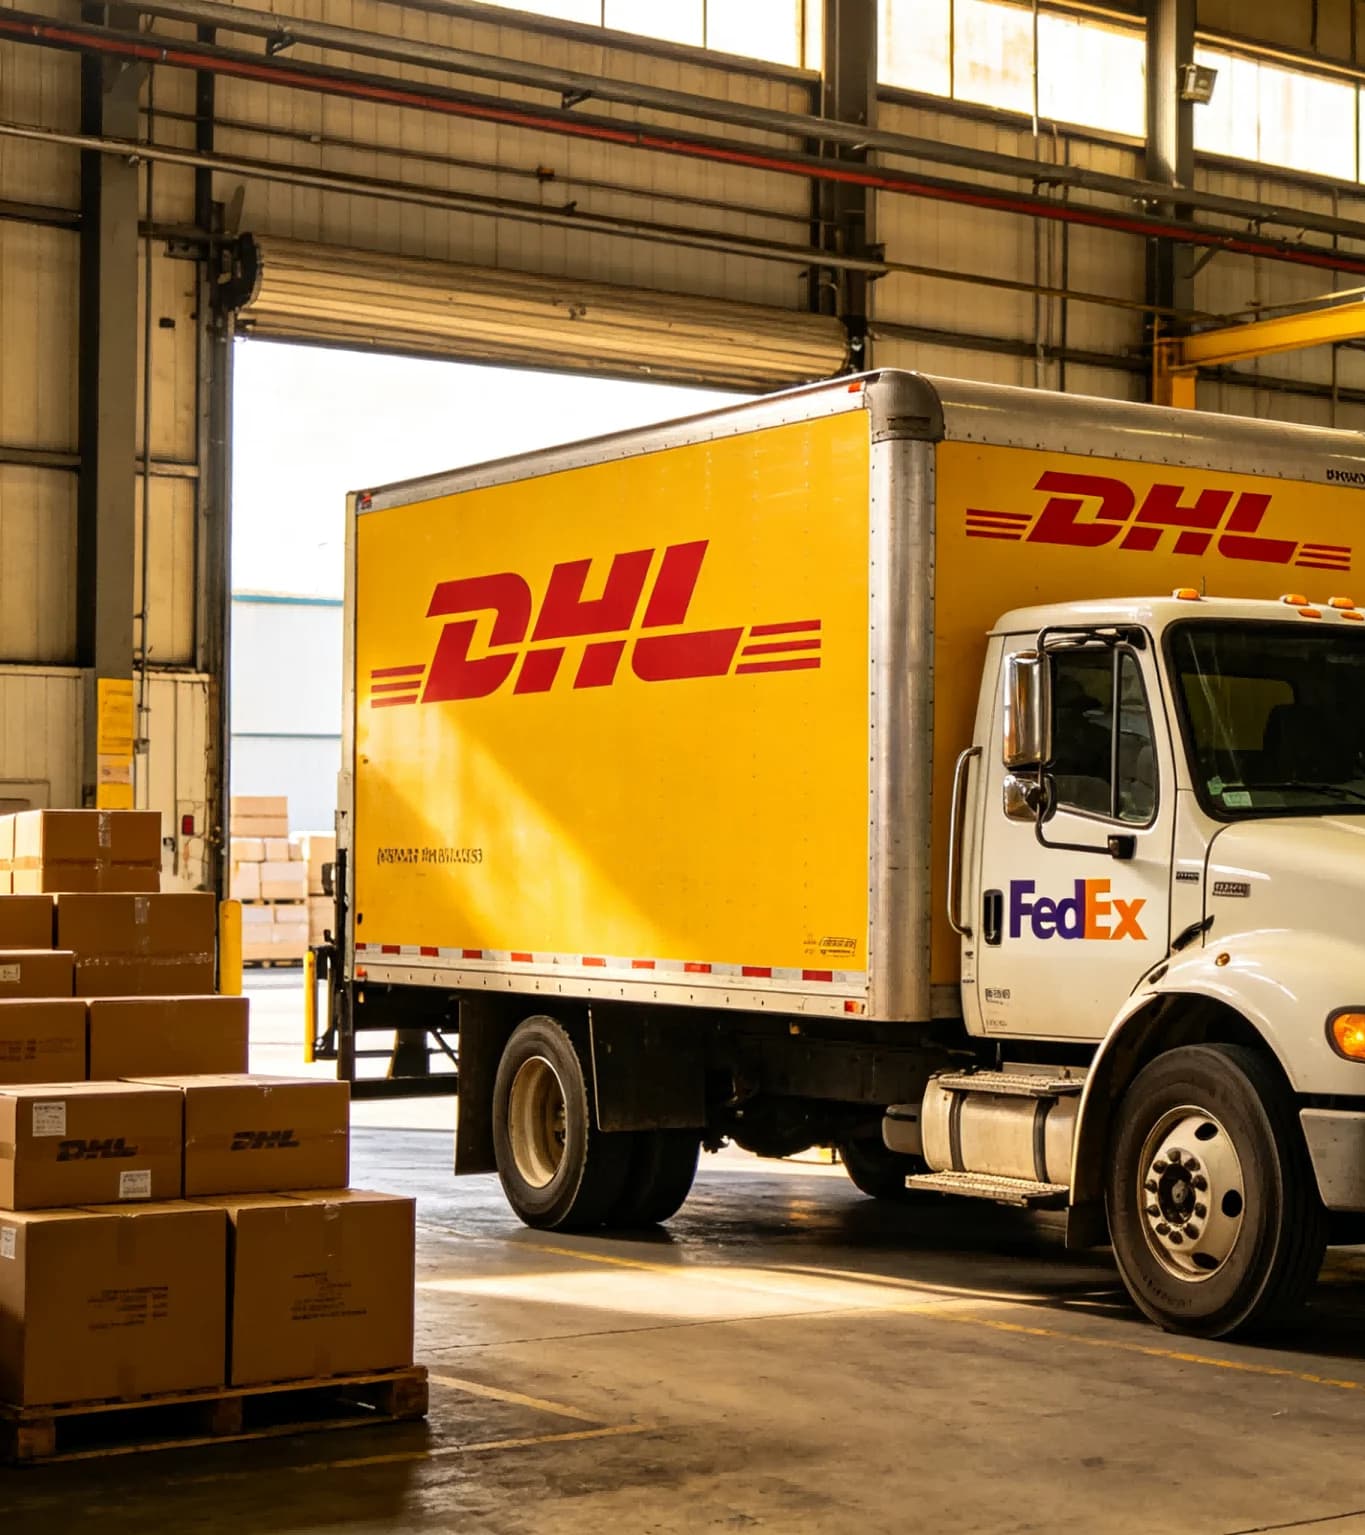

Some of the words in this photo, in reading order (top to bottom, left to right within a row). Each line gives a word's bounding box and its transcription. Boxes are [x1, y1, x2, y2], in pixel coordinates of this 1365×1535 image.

[1024, 470, 1300, 565] DHL
[421, 539, 745, 704] DHL
[1009, 878, 1148, 941] FedEx
[56, 1137, 138, 1162] DHL
[231, 1129, 300, 1152] DHL
